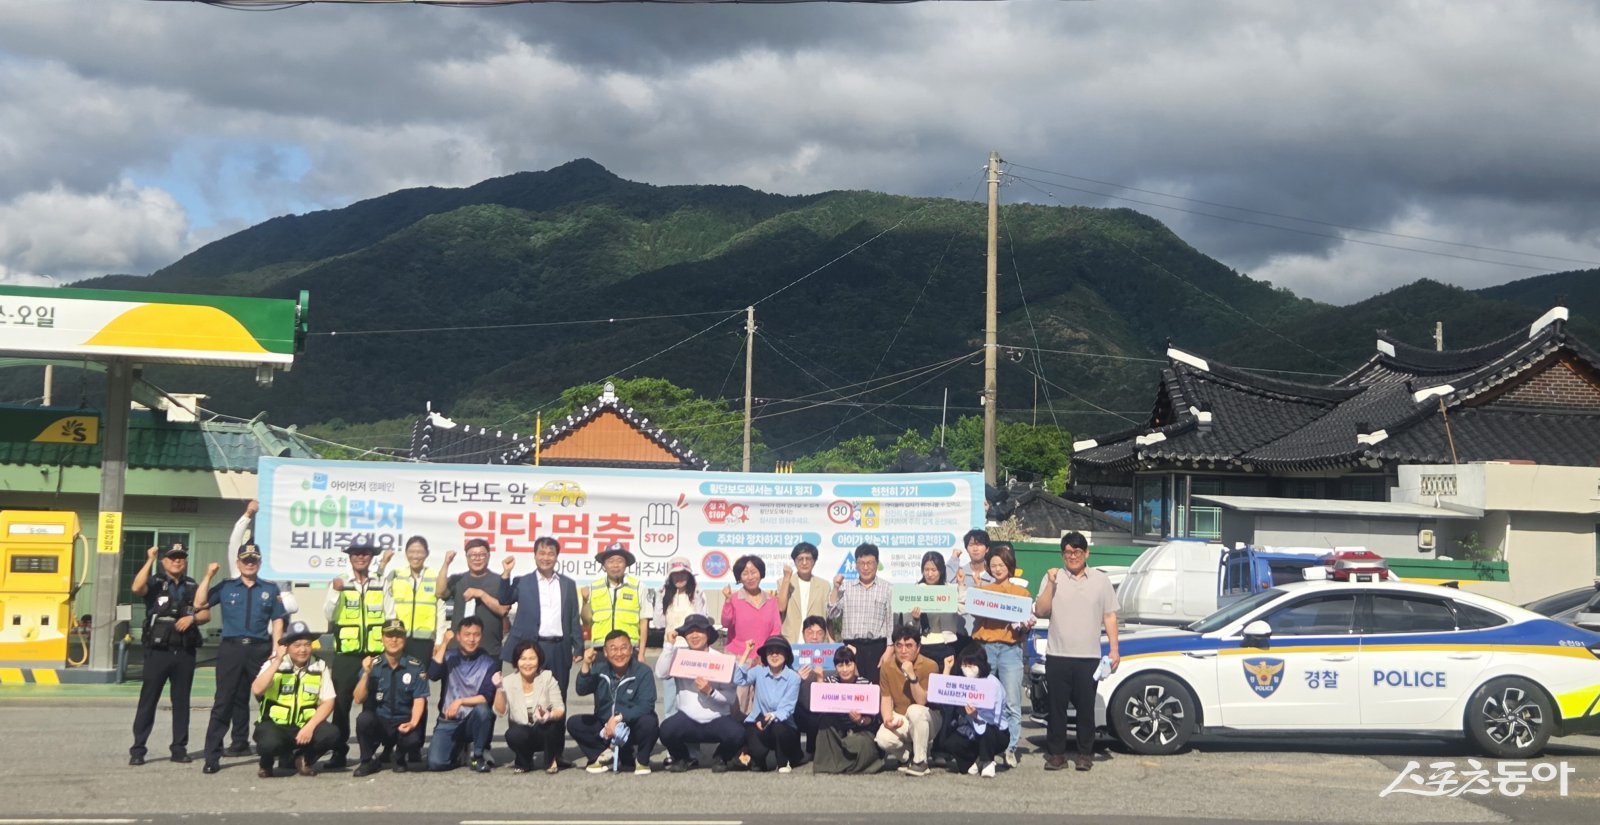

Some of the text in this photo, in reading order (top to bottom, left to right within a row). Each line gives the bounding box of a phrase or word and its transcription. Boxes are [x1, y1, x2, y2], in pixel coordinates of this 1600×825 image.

[331, 480, 395, 492] 아이먼저 캠페인
[795, 486, 812, 496] 정지
[871, 486, 918, 496] 천천히 가기
[418, 480, 529, 505] 횡단보도 앞
[289, 495, 404, 530] 아이먼저
[708, 510, 726, 519] STOP
[833, 506, 848, 516] 30
[458, 511, 635, 554] 일단 멈춤
[644, 532, 674, 544] STOP
[838, 536, 862, 546] 아이가
[973, 598, 986, 607] NO!
[986, 600, 999, 609] NO!
[1304, 670, 1339, 689] 경찰
[1373, 671, 1446, 688] POLICE
[854, 694, 865, 702] NO
[968, 692, 985, 701] OUT!
